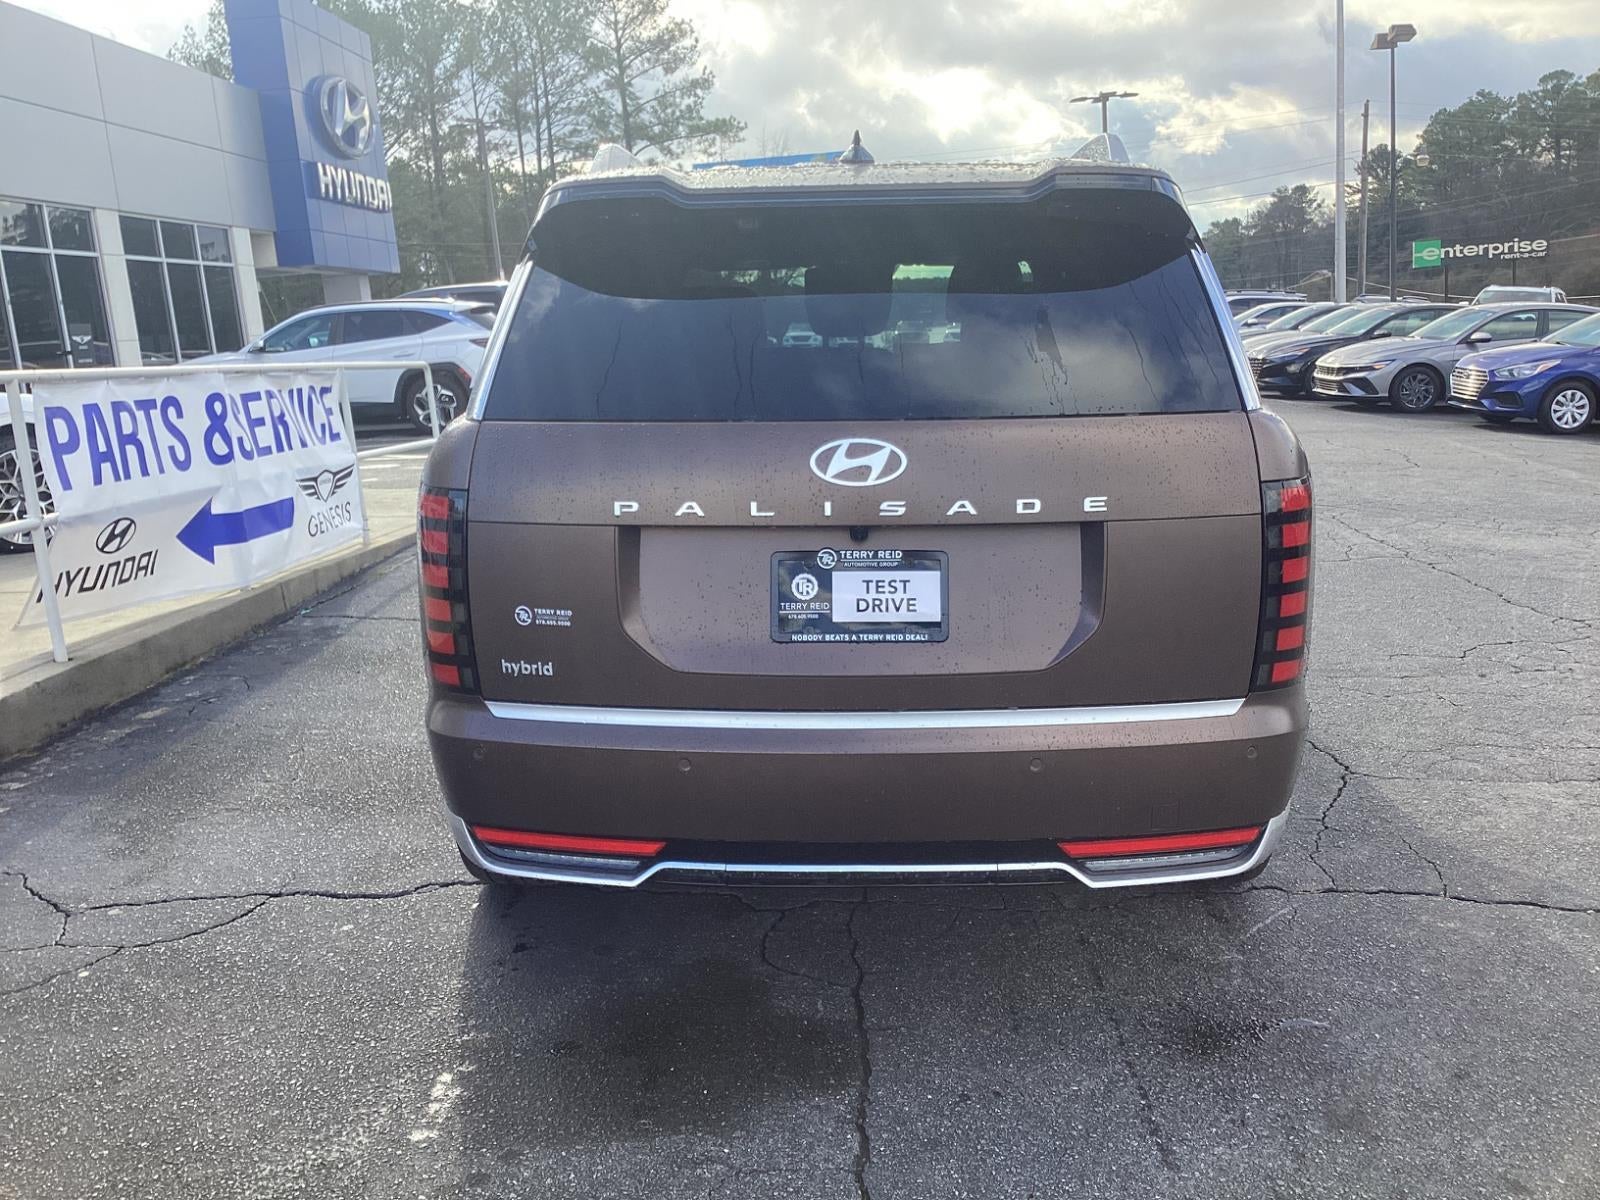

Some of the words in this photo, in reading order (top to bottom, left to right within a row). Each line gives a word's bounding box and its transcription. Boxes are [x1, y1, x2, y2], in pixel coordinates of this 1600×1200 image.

[317, 162, 393, 210] HYUNDAI
[1421, 238, 1548, 260] enterprise
[1500, 250, 1548, 260] rent-a-car
[44, 395, 191, 491] PARTS
[614, 496, 1108, 517] PALISADE
[308, 501, 351, 537] GENESIS
[840, 550, 874, 559] TERRY
[878, 550, 903, 559] REID
[862, 579, 911, 594] TEST
[534, 608, 555, 616] TERRY
[556, 609, 573, 617] REID
[780, 602, 808, 610] TERRY
[810, 602, 830, 610] REID
[856, 598, 917, 612] DRIVE
[501, 659, 553, 676] hybrid
